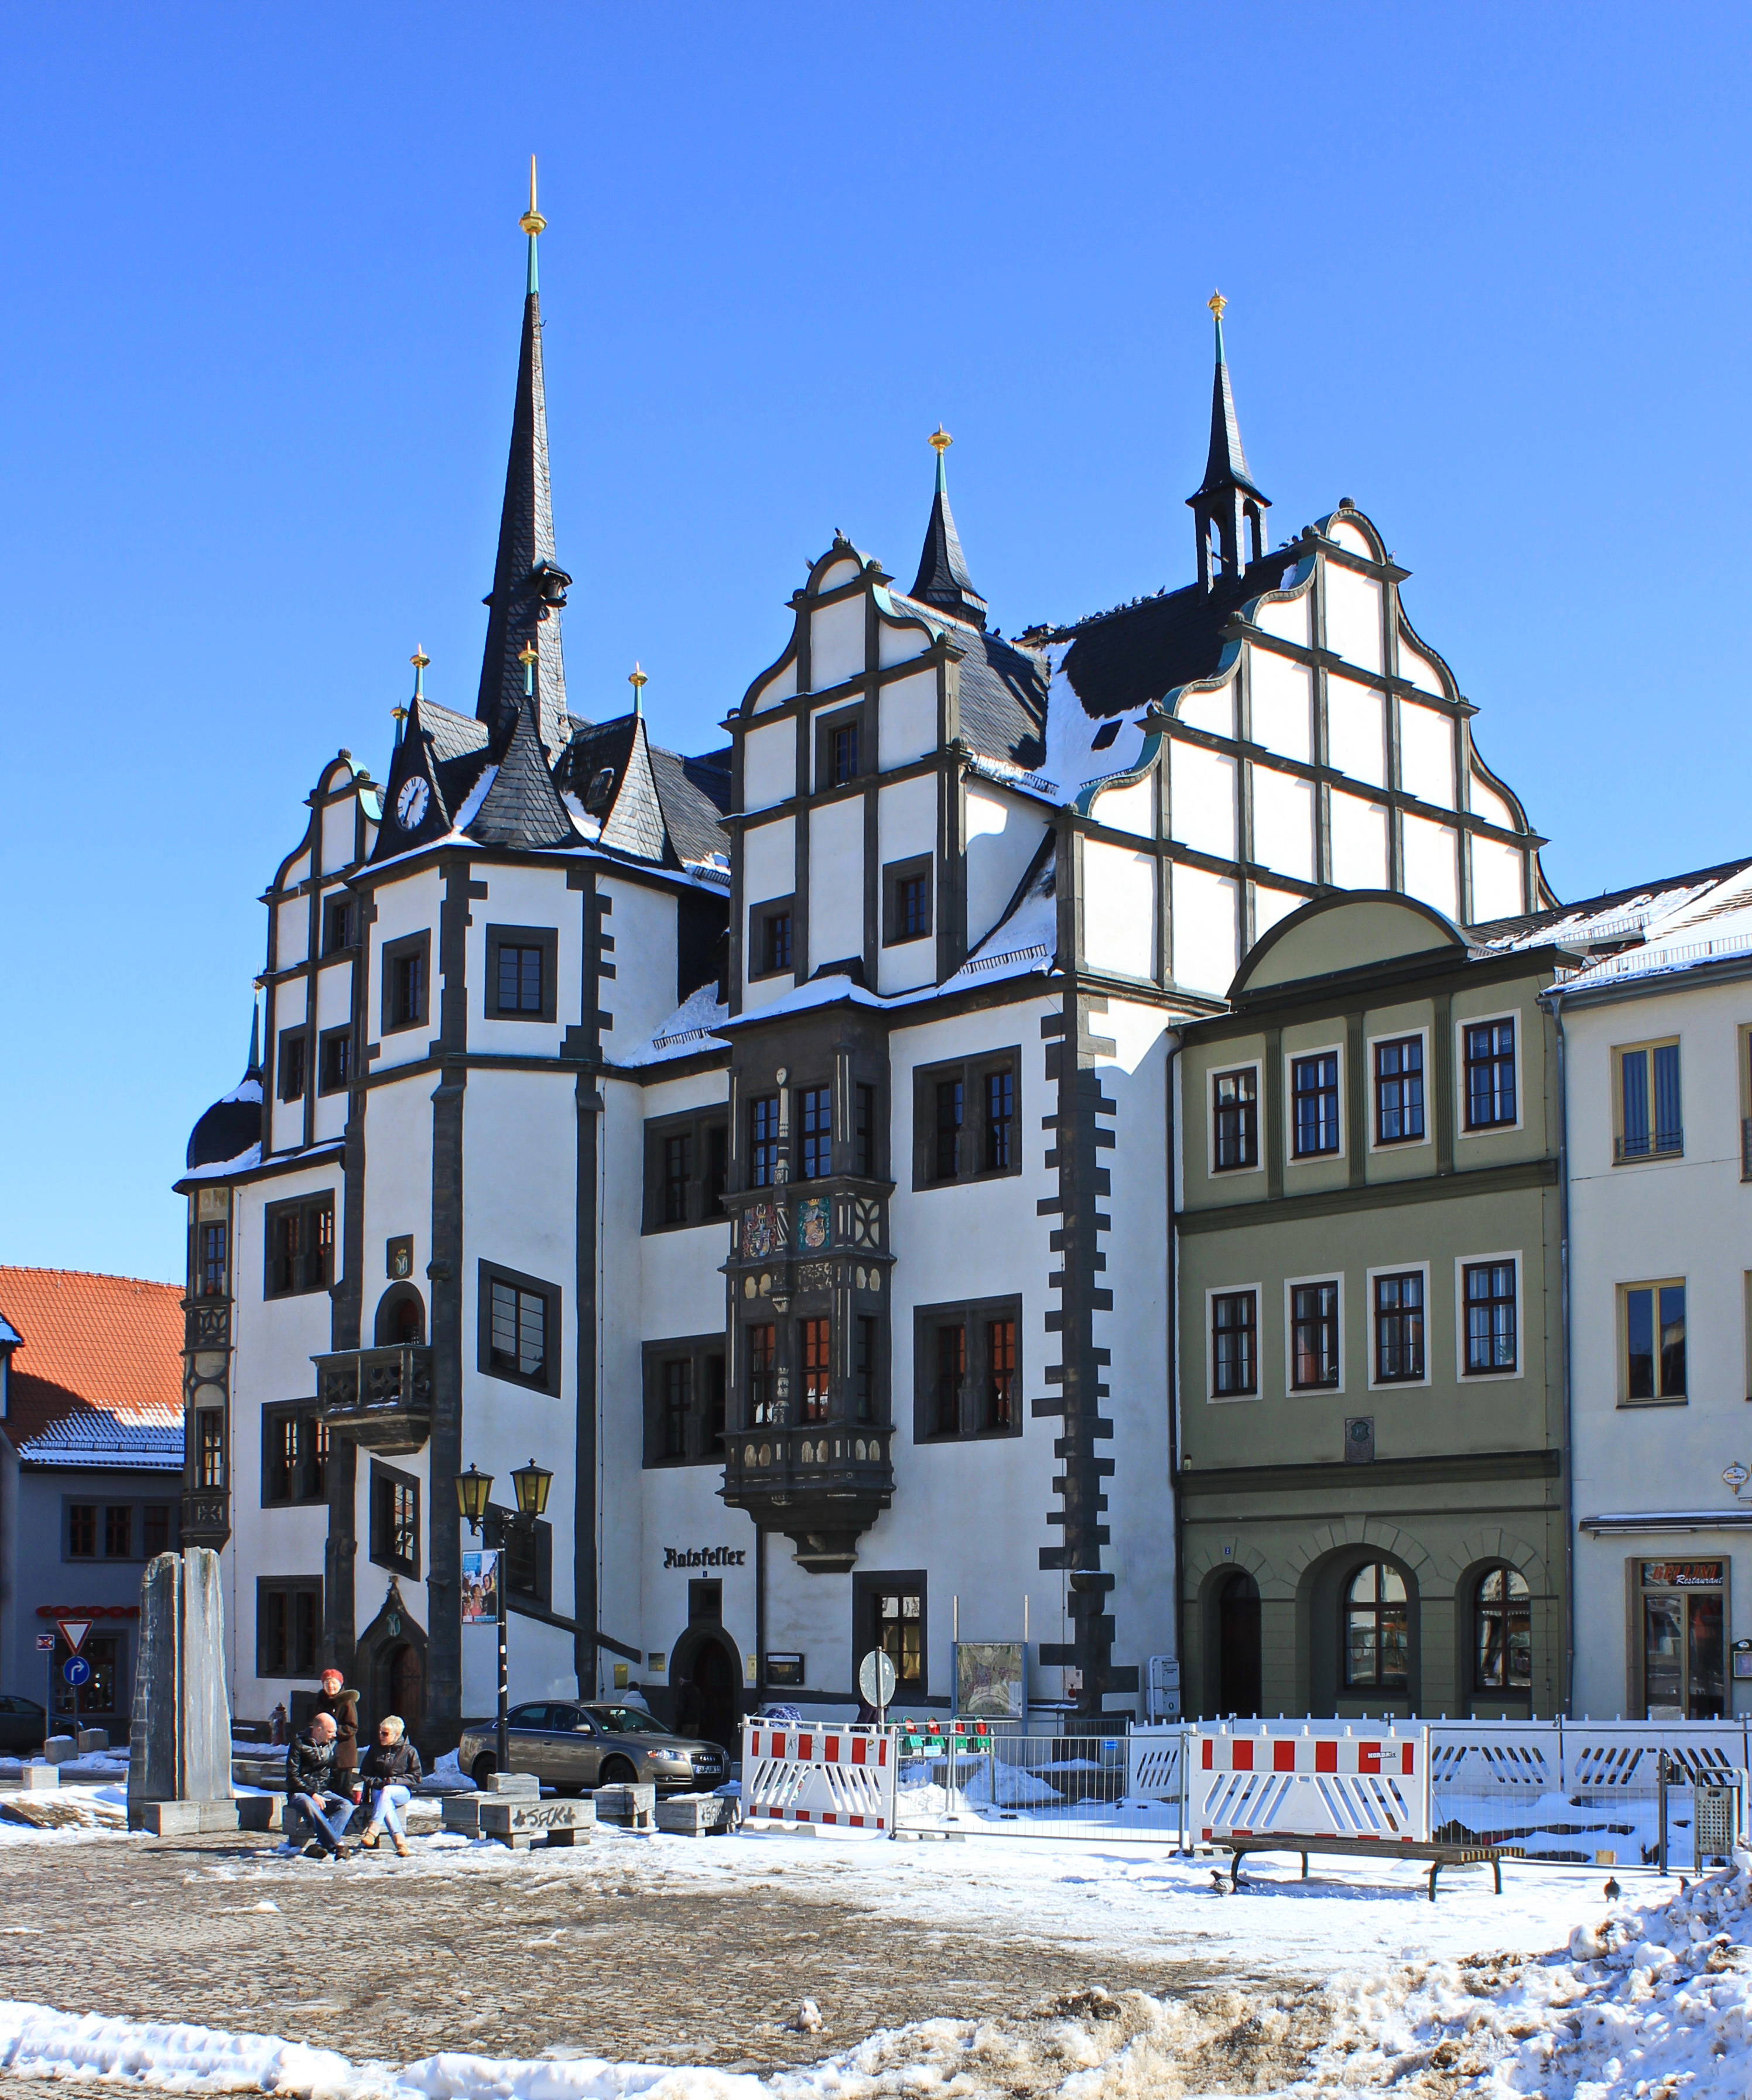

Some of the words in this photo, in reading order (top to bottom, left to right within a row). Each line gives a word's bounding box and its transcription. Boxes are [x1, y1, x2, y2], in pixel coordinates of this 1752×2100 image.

[663, 1546, 746, 1568] Ratskeller
[1652, 1564, 1717, 1580] BELLINI
[1676, 1574, 1723, 1584] Restaurant
